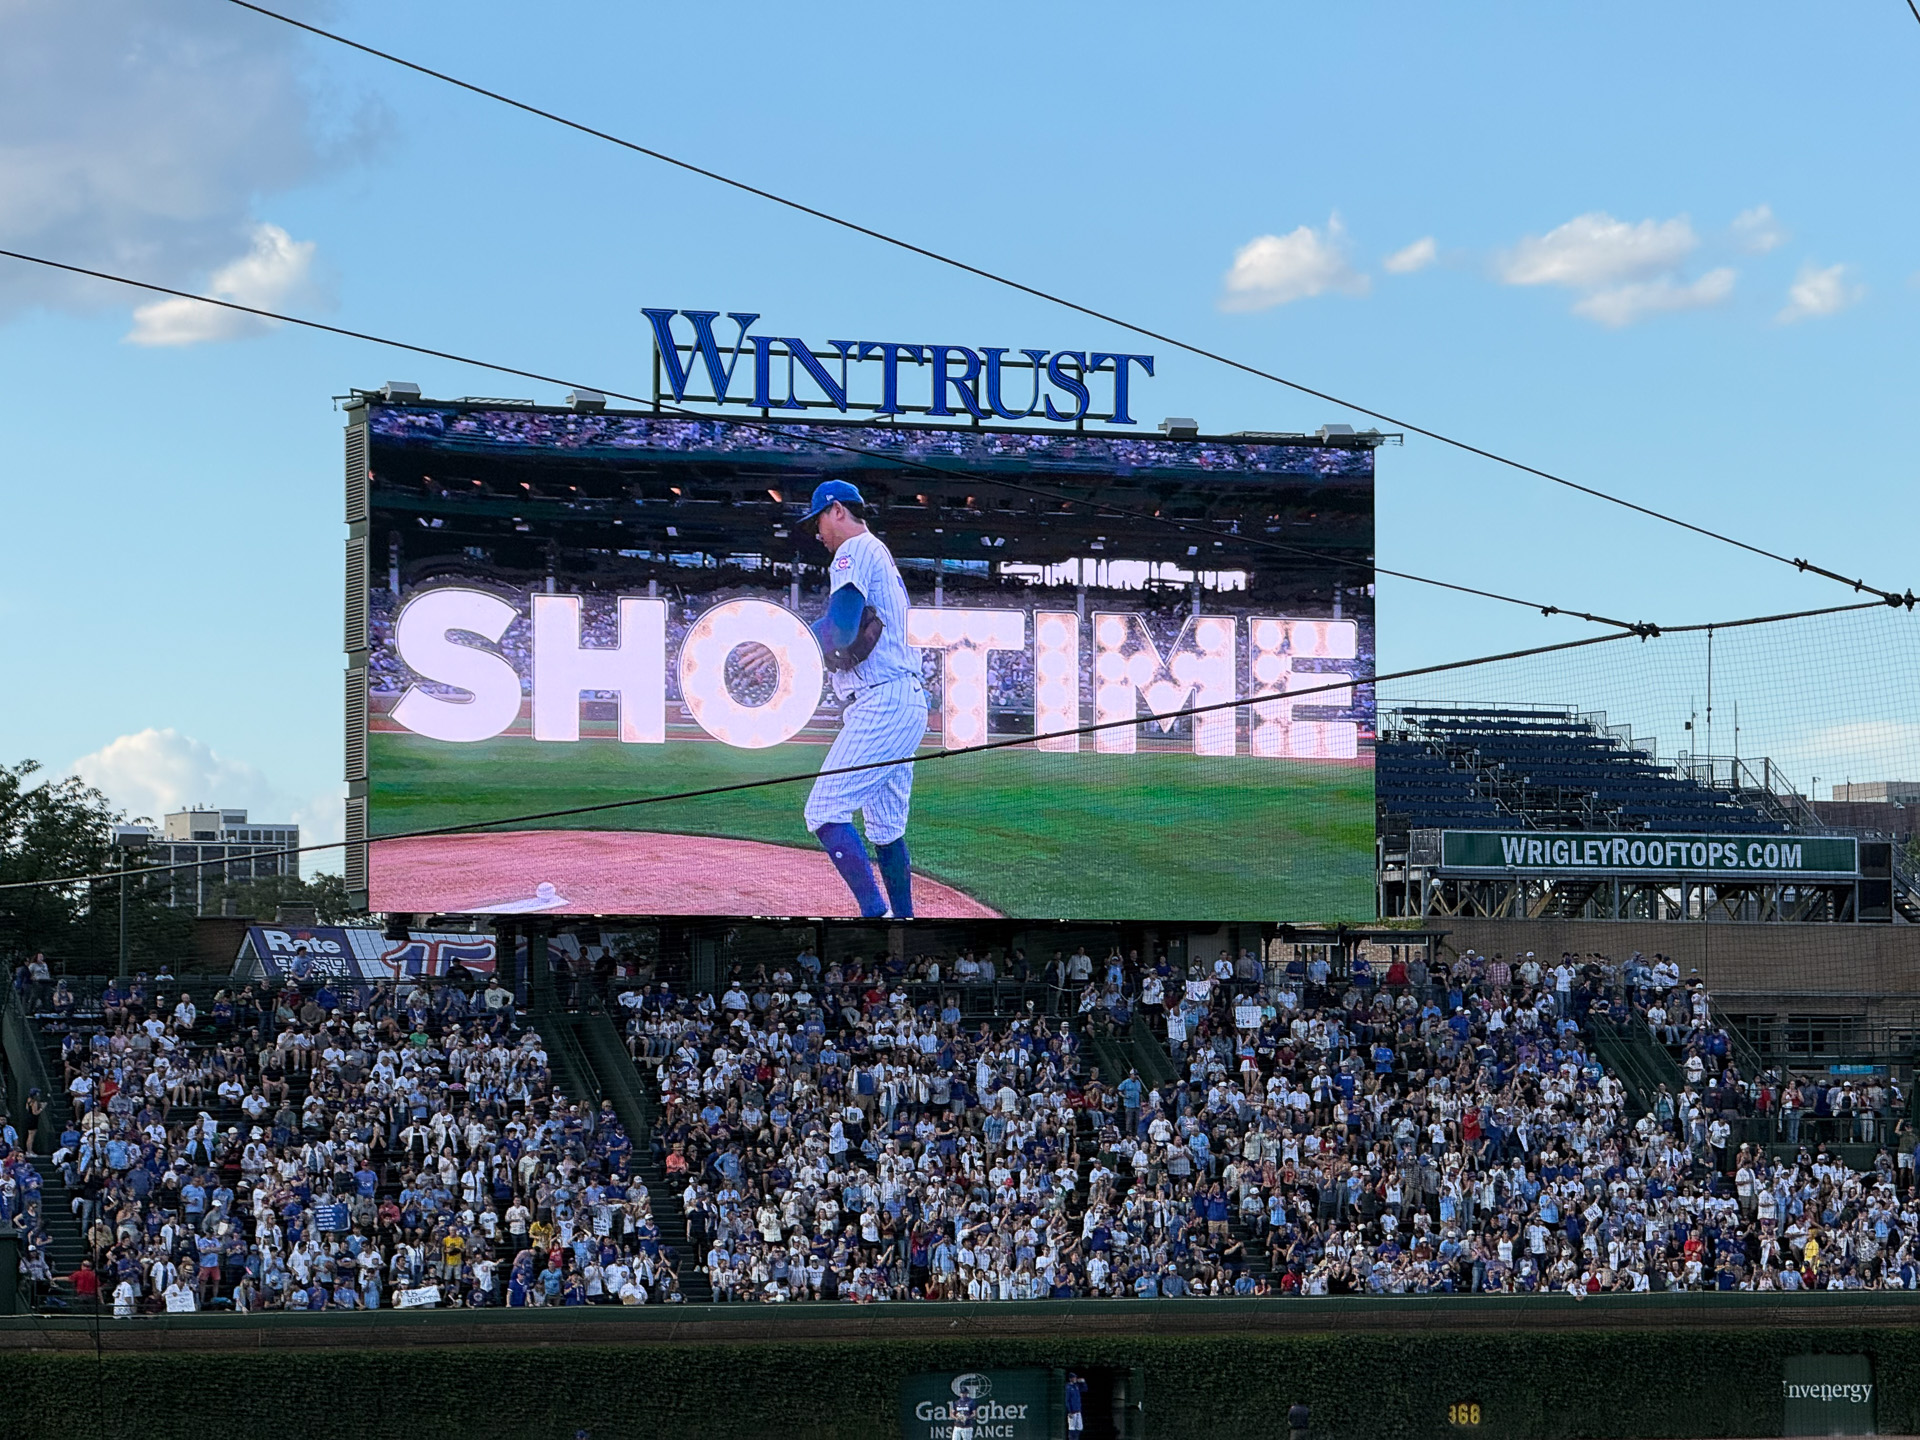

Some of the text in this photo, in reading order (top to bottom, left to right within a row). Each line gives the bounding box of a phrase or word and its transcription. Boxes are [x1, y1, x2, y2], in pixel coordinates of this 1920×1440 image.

[262, 929, 341, 954] Rate
[1782, 1380, 1873, 1403] Invenergy
[915, 1400, 1028, 1424] Galgher
[1448, 1403, 1481, 1425] 368
[930, 1425, 1014, 1439] INSANCE
